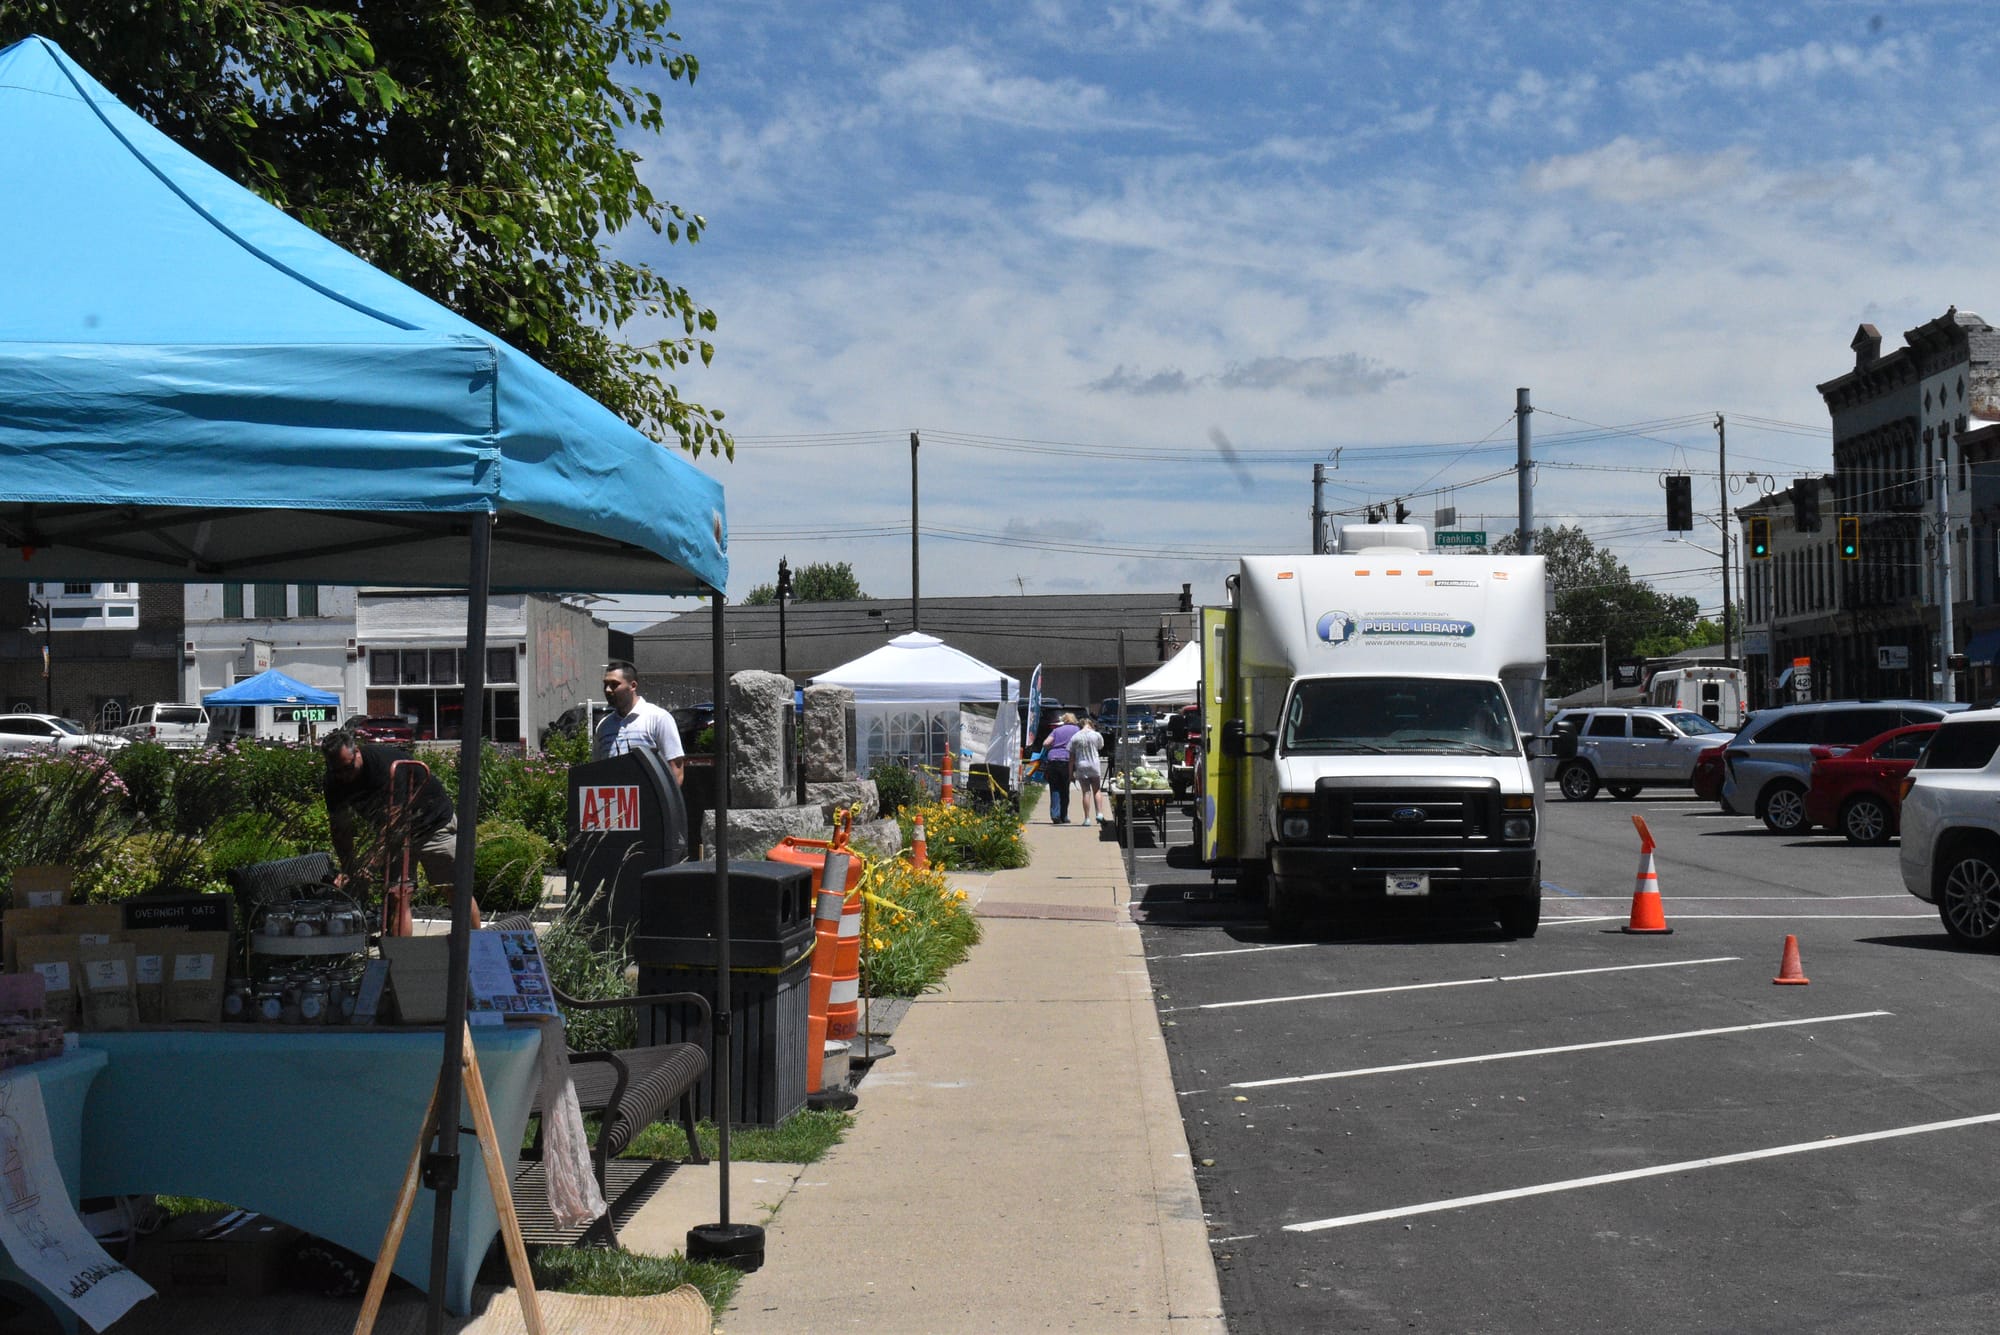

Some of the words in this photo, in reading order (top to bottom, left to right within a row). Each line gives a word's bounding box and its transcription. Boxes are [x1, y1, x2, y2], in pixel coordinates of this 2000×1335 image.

[1437, 534, 1472, 545] Franklin
[1474, 534, 1484, 544] St
[1364, 622, 1409, 632] PUBLIC
[1414, 623, 1466, 634] LIBRARY
[292, 709, 325, 721] OPEN
[581, 787, 639, 829] ATM
[135, 906, 185, 919] OVERNIGHT
[191, 905, 216, 917] OATS
